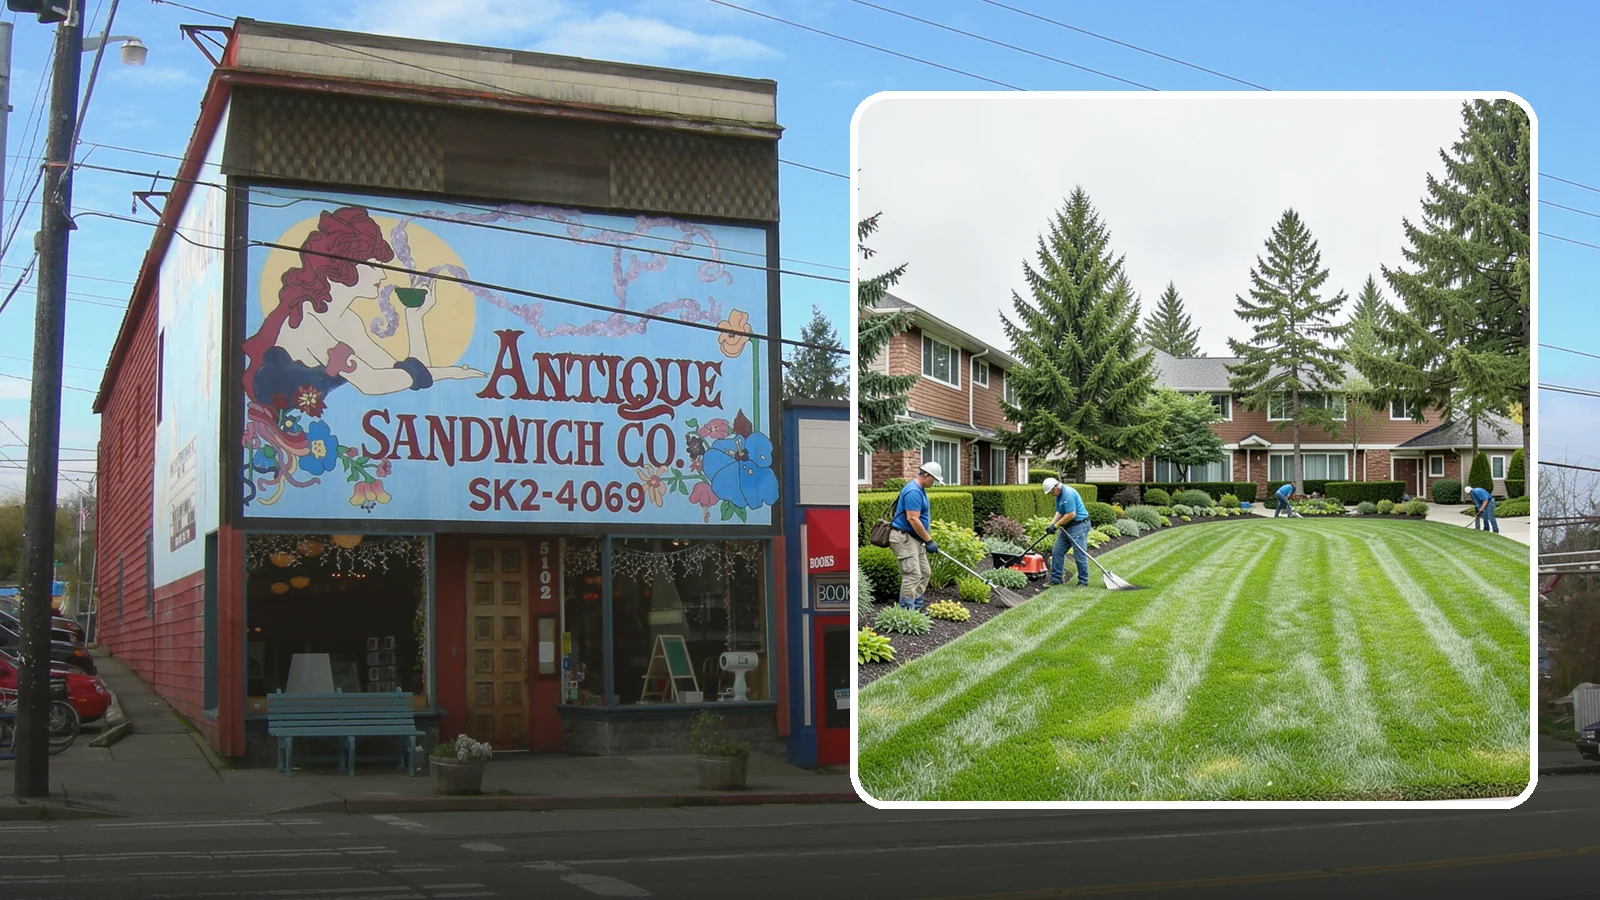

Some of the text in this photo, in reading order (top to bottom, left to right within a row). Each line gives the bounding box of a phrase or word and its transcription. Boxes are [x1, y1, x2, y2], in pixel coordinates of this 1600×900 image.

[476, 329, 724, 421] ANTIQUE
[361, 408, 686, 469] SANDWICH CO.
[468, 476, 647, 514] SK2-4069
[540, 541, 551, 599] 5102
[809, 555, 835, 569] BOOKS
